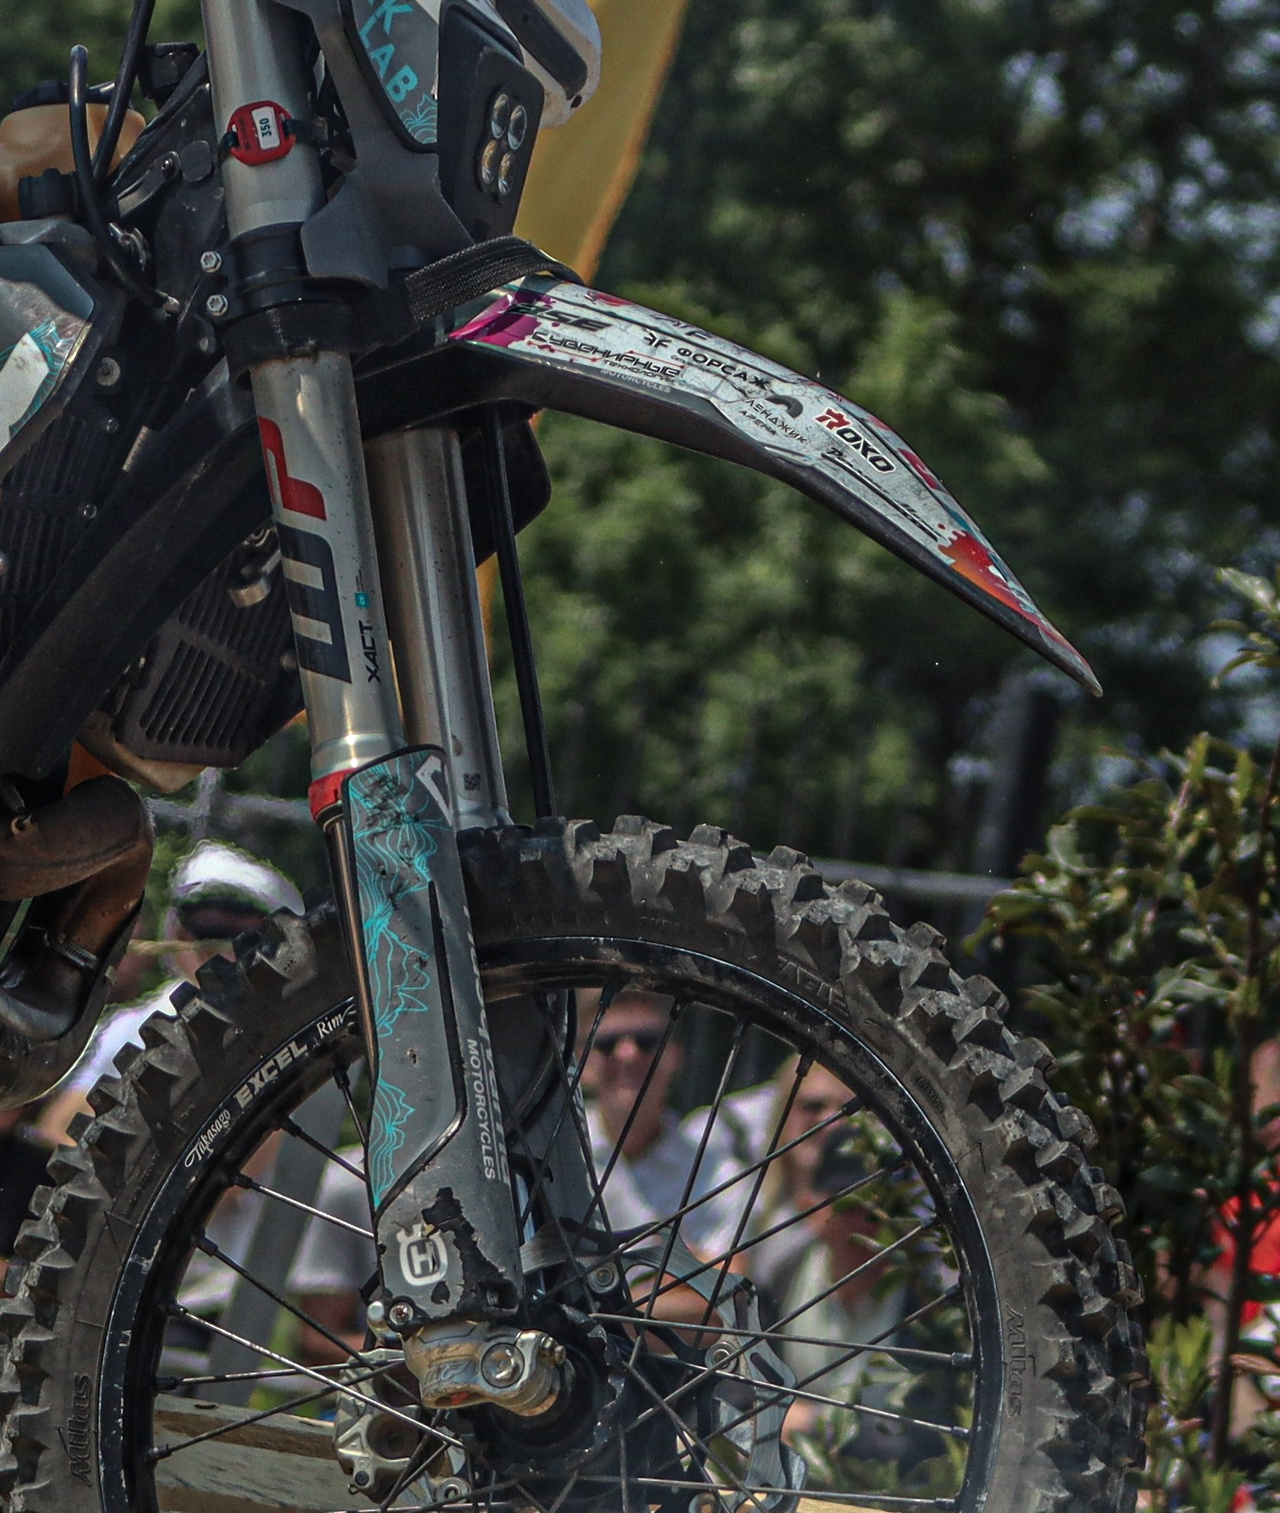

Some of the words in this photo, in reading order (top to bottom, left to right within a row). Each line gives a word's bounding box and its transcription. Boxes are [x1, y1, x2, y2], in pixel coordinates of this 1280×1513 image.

[358, 12, 419, 103] LAB
[258, 117, 272, 138] 350
[531, 331, 681, 378] СУВЕНИРНЫЕ
[677, 347, 770, 391] ФОРСАЖ
[815, 407, 896, 473] ROXO
[358, 619, 382, 684] XACT
[184, 1108, 232, 1169] Takasago
[232, 1040, 309, 1109] EXCEL
[316, 1006, 350, 1040] Rim
[466, 1038, 496, 1181] MOTORCYCLES
[1004, 1302, 1026, 1418] Mitas
[67, 1371, 93, 1488] Mitas
